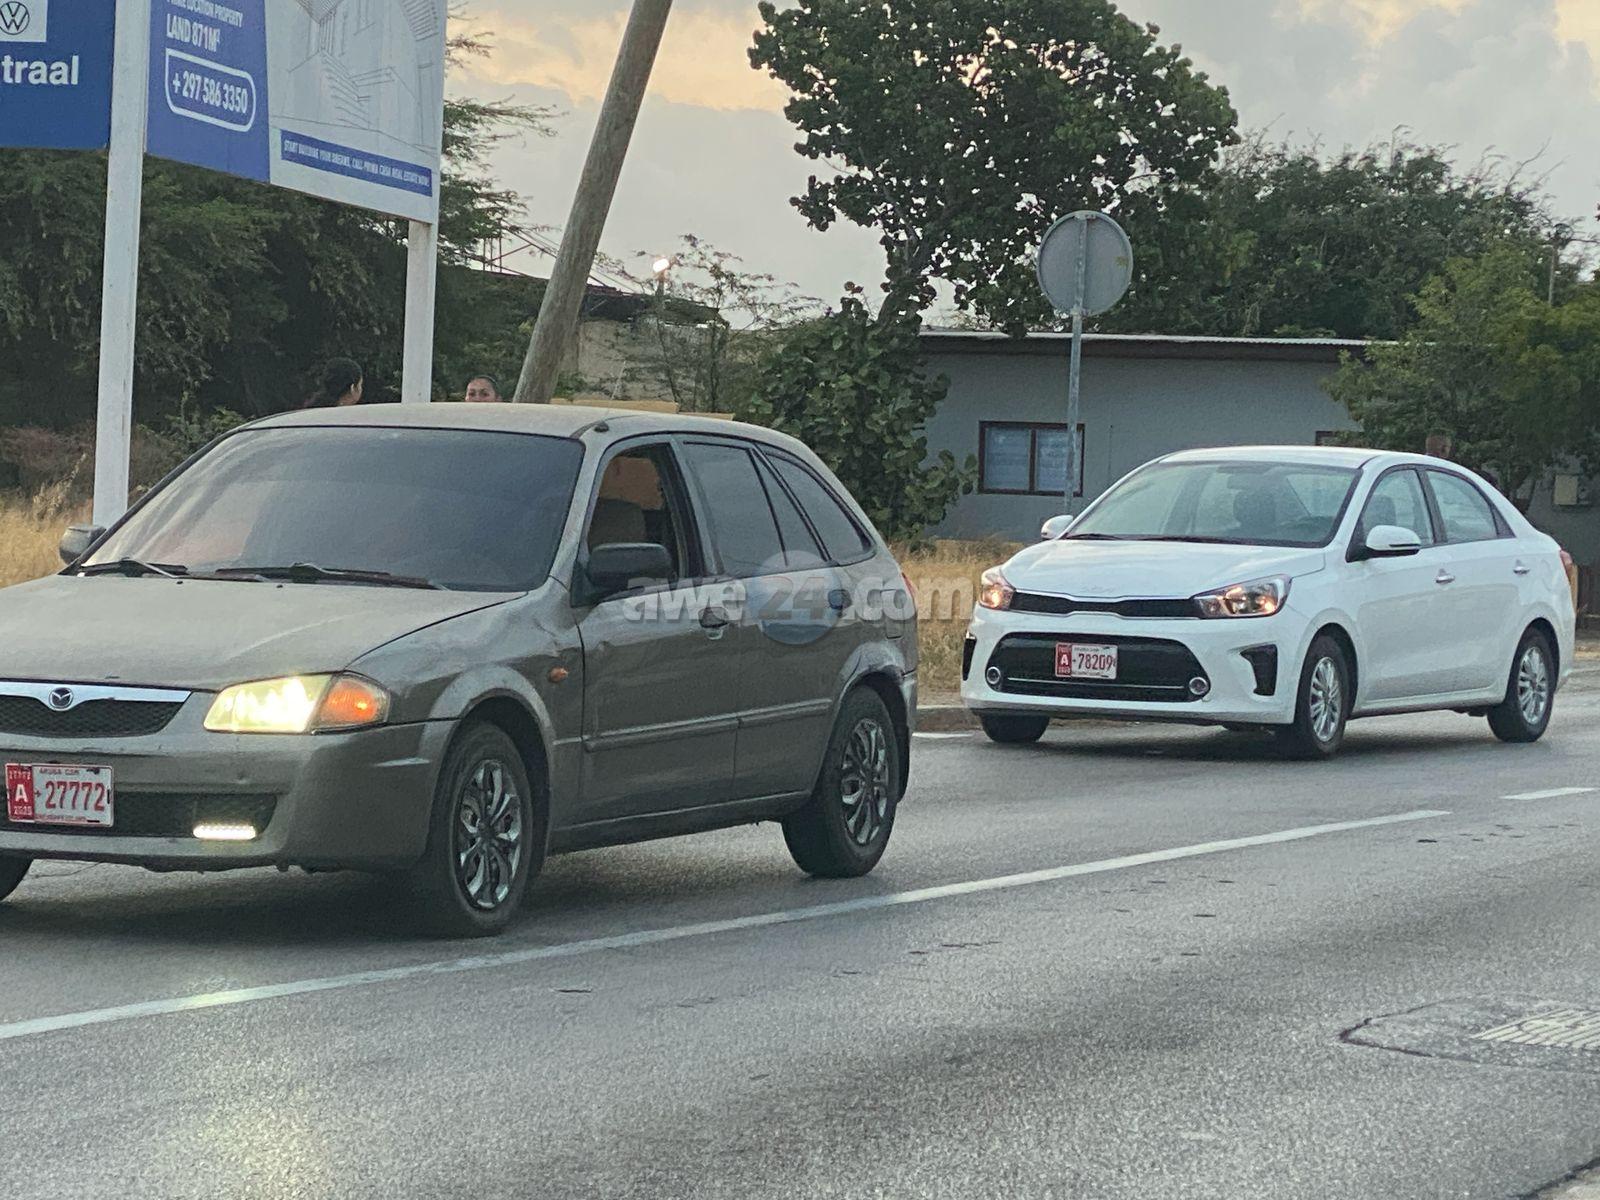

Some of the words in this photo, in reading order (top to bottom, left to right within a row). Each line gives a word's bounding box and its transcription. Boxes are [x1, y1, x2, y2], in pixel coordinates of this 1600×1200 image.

[167, 13, 191, 43] LAND
[214, 3, 243, 28] PROPERTY
[1, 54, 79, 85] traal
[202, 76, 221, 107] 586
[222, 82, 248, 114] 3350
[1060, 653, 1069, 666] A
[1078, 652, 1113, 672] 78209
[15, 783, 28, 802] A
[45, 780, 105, 812] 27772
